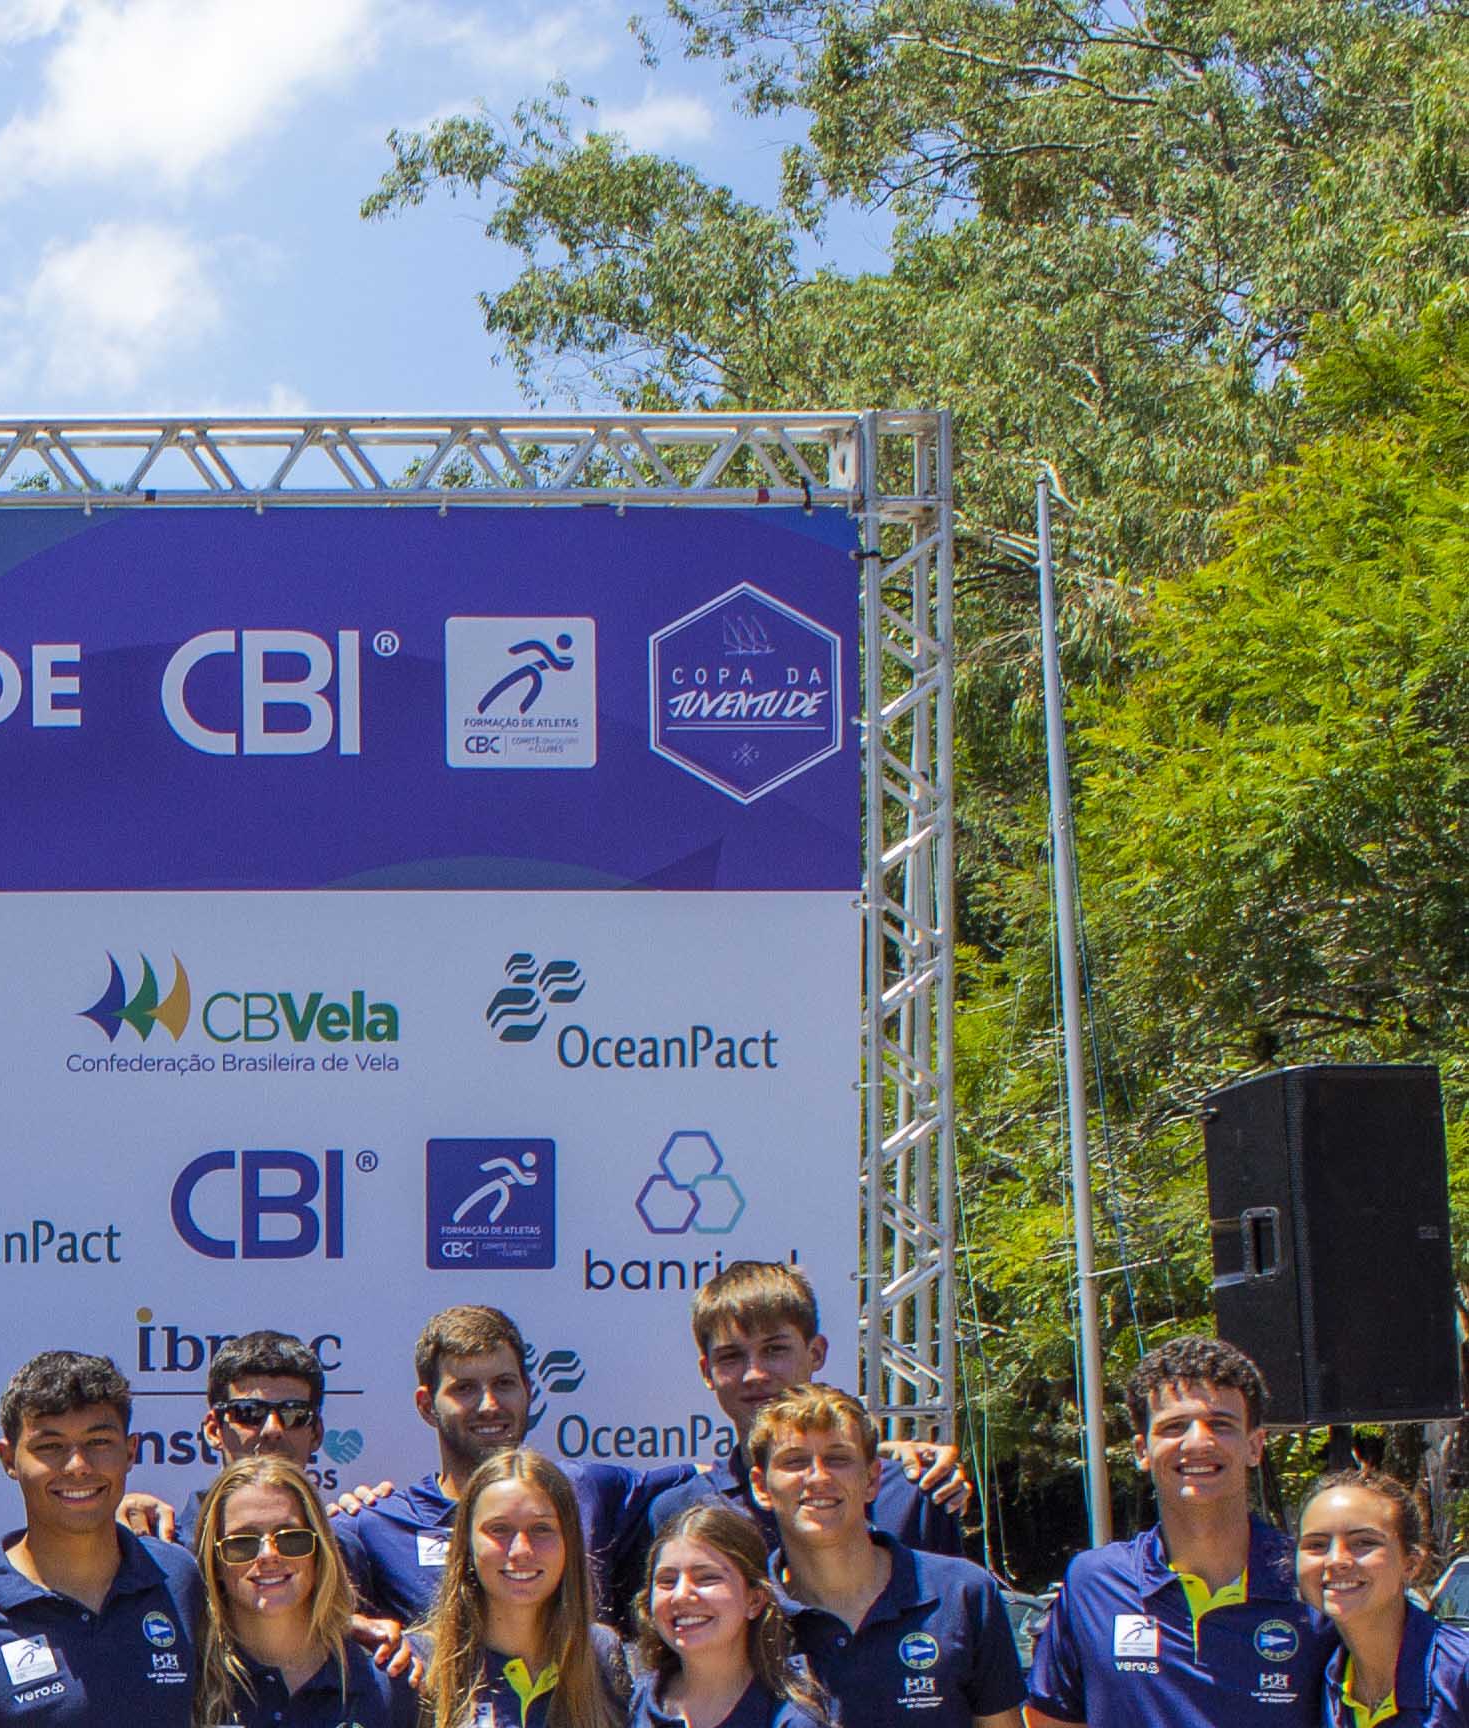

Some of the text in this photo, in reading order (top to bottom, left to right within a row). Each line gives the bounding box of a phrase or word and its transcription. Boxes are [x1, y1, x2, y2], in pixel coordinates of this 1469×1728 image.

[671, 666, 823, 685] COPA DA
[668, 689, 827, 718] JUVENTUDE
[464, 717, 579, 730] FORMAÇÃO DE ATLETAS
[465, 736, 500, 754] CBC
[203, 990, 400, 1043] CBVela
[557, 1024, 779, 1070] OceanPact
[66, 1053, 400, 1076] Confederação Brasileira de Vela
[441, 1225, 541, 1236] FORMAÇÃO DE ATLETAS
[441, 1241, 474, 1258] CBC
[584, 1248, 798, 1291] banri
[137, 1307, 343, 1373] ibc
[557, 1414, 737, 1458] OceanPa
[15, 1686, 50, 1704] vero
